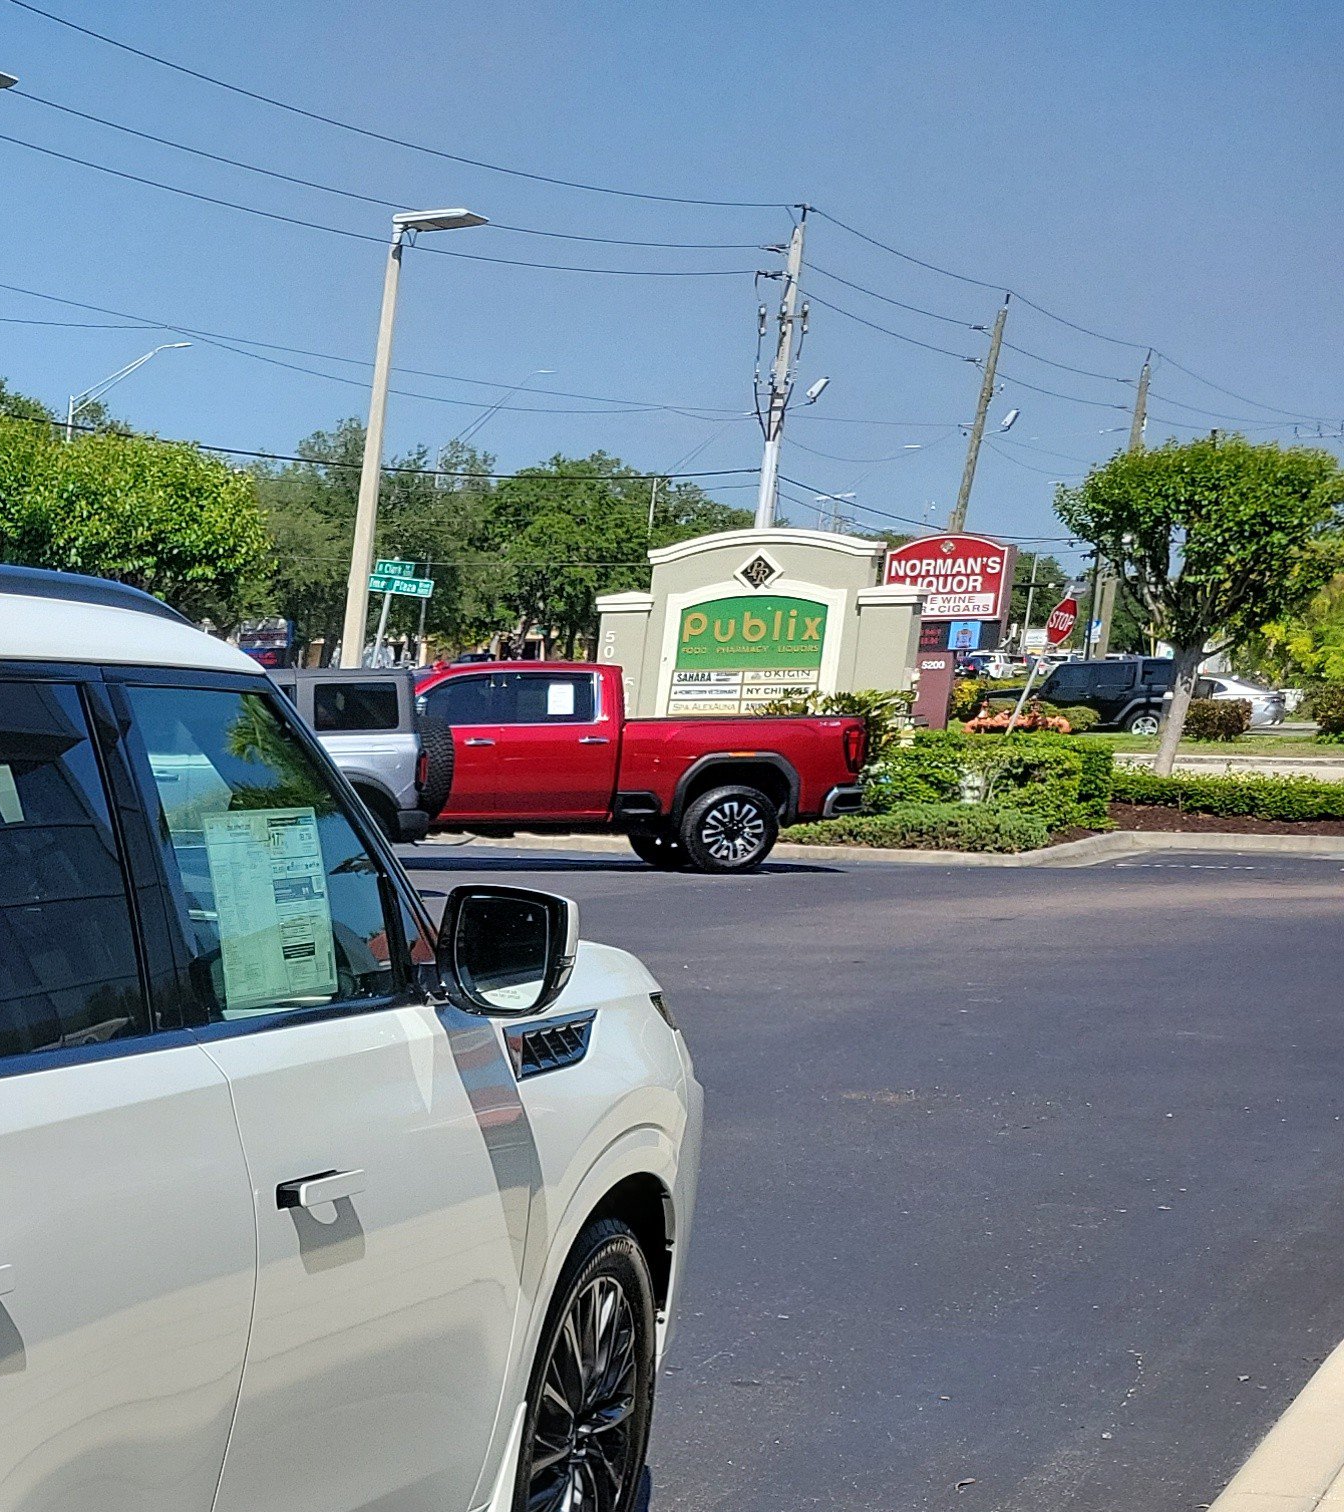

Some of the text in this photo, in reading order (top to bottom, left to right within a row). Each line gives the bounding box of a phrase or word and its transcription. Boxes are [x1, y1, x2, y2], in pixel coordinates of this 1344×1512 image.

[890, 556, 1001, 577] NORMAN'S
[941, 595, 976, 605] WINE
[937, 604, 990, 613] CIGARS
[1049, 611, 1073, 630] STOP
[683, 610, 822, 642] Publix
[921, 660, 945, 669] 5200
[676, 672, 711, 682] SAHARA
[746, 687, 761, 695] NY
